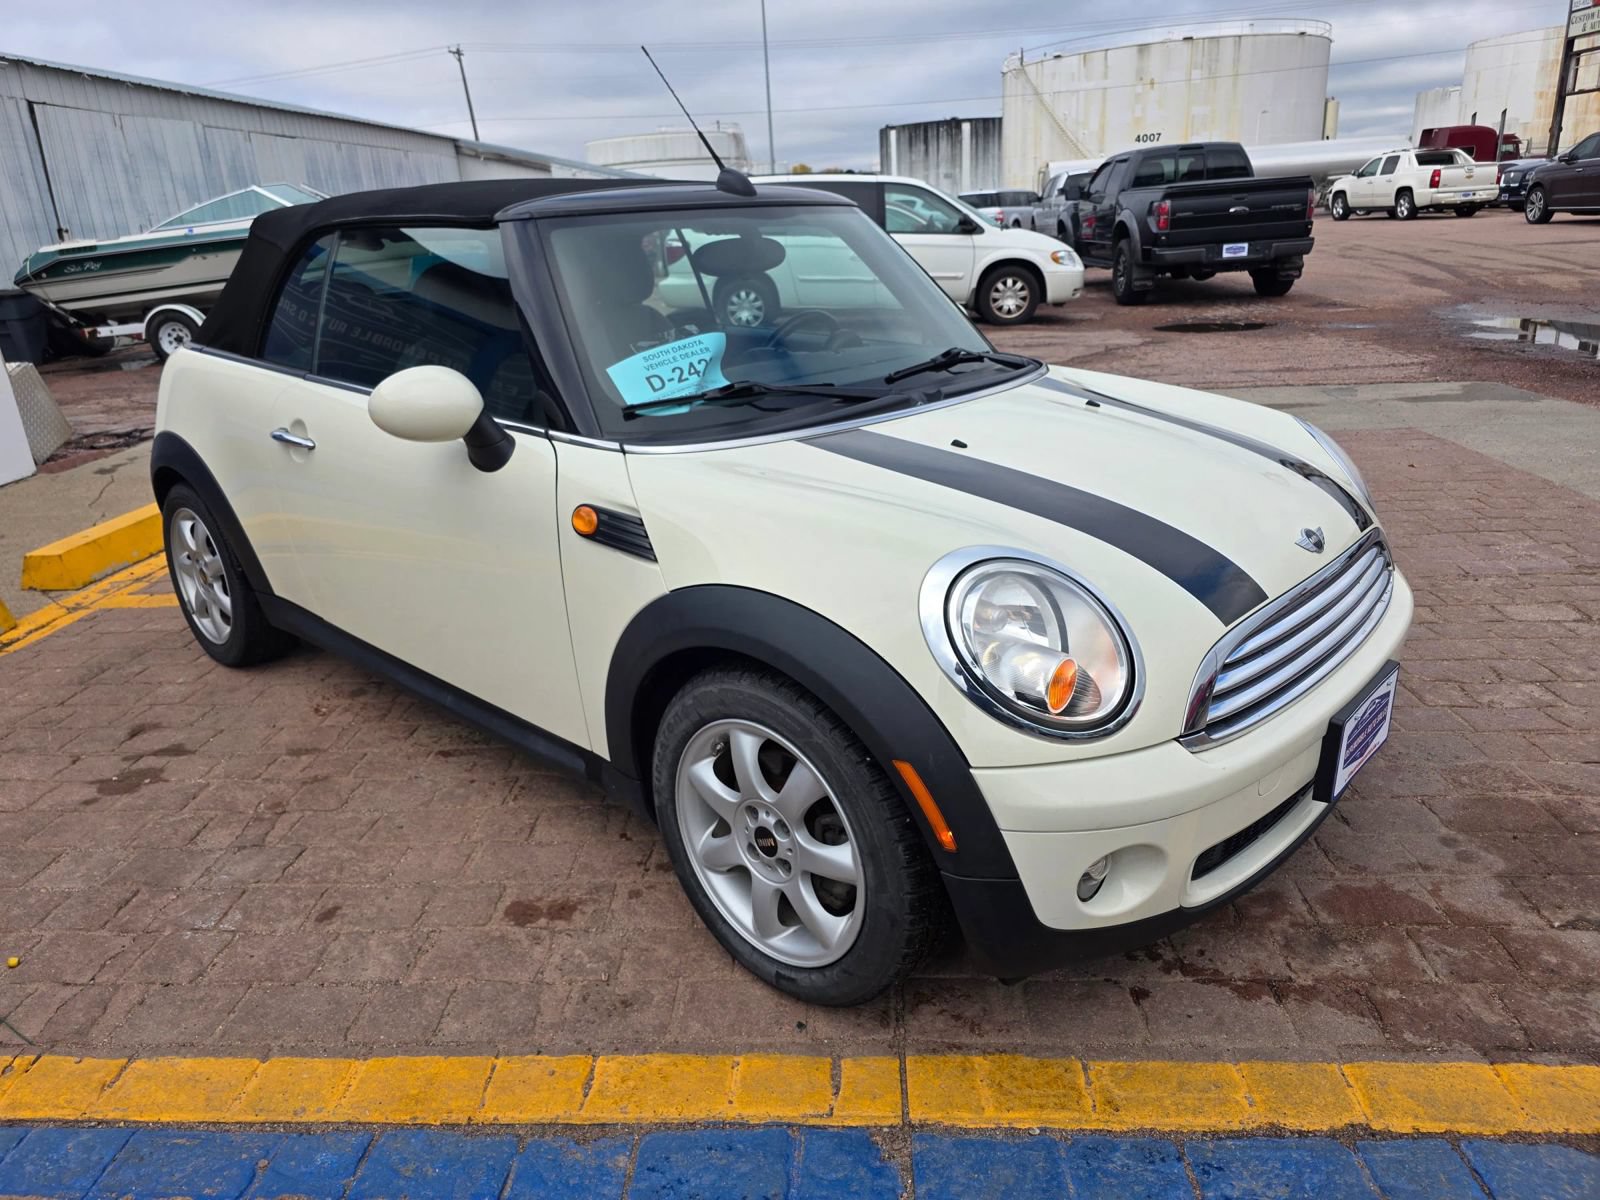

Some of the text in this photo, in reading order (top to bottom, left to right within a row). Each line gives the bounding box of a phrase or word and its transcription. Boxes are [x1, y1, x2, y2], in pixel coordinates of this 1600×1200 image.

[1135, 132, 1162, 143] 4007
[642, 339, 705, 363] SOUTH DAKOTA
[643, 346, 712, 372] VEHICLE DEALER
[645, 357, 713, 392] D-242
